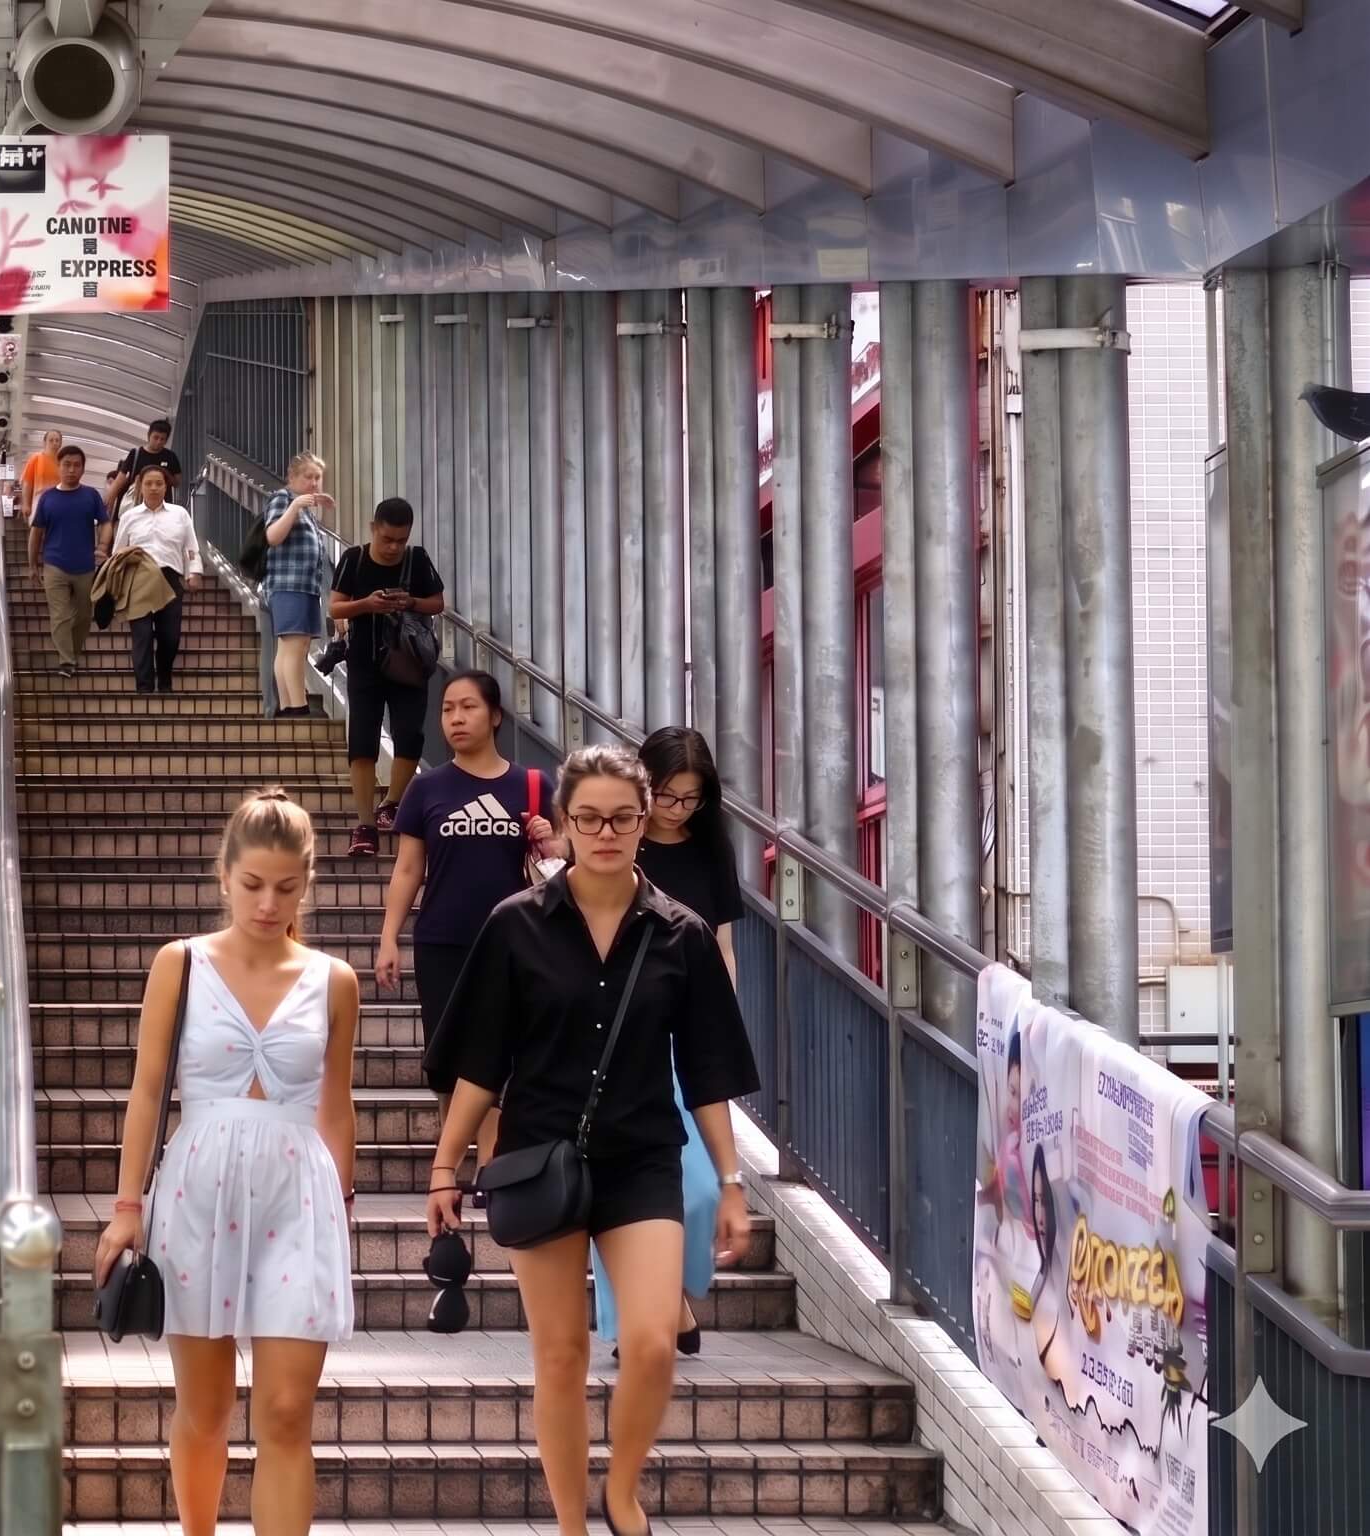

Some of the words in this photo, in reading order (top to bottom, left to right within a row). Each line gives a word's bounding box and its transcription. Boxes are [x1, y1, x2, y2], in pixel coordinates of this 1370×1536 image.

[46, 217, 132, 235] CANOTNE
[60, 259, 157, 278] EXPPRESS
[439, 818, 520, 837] adidas
